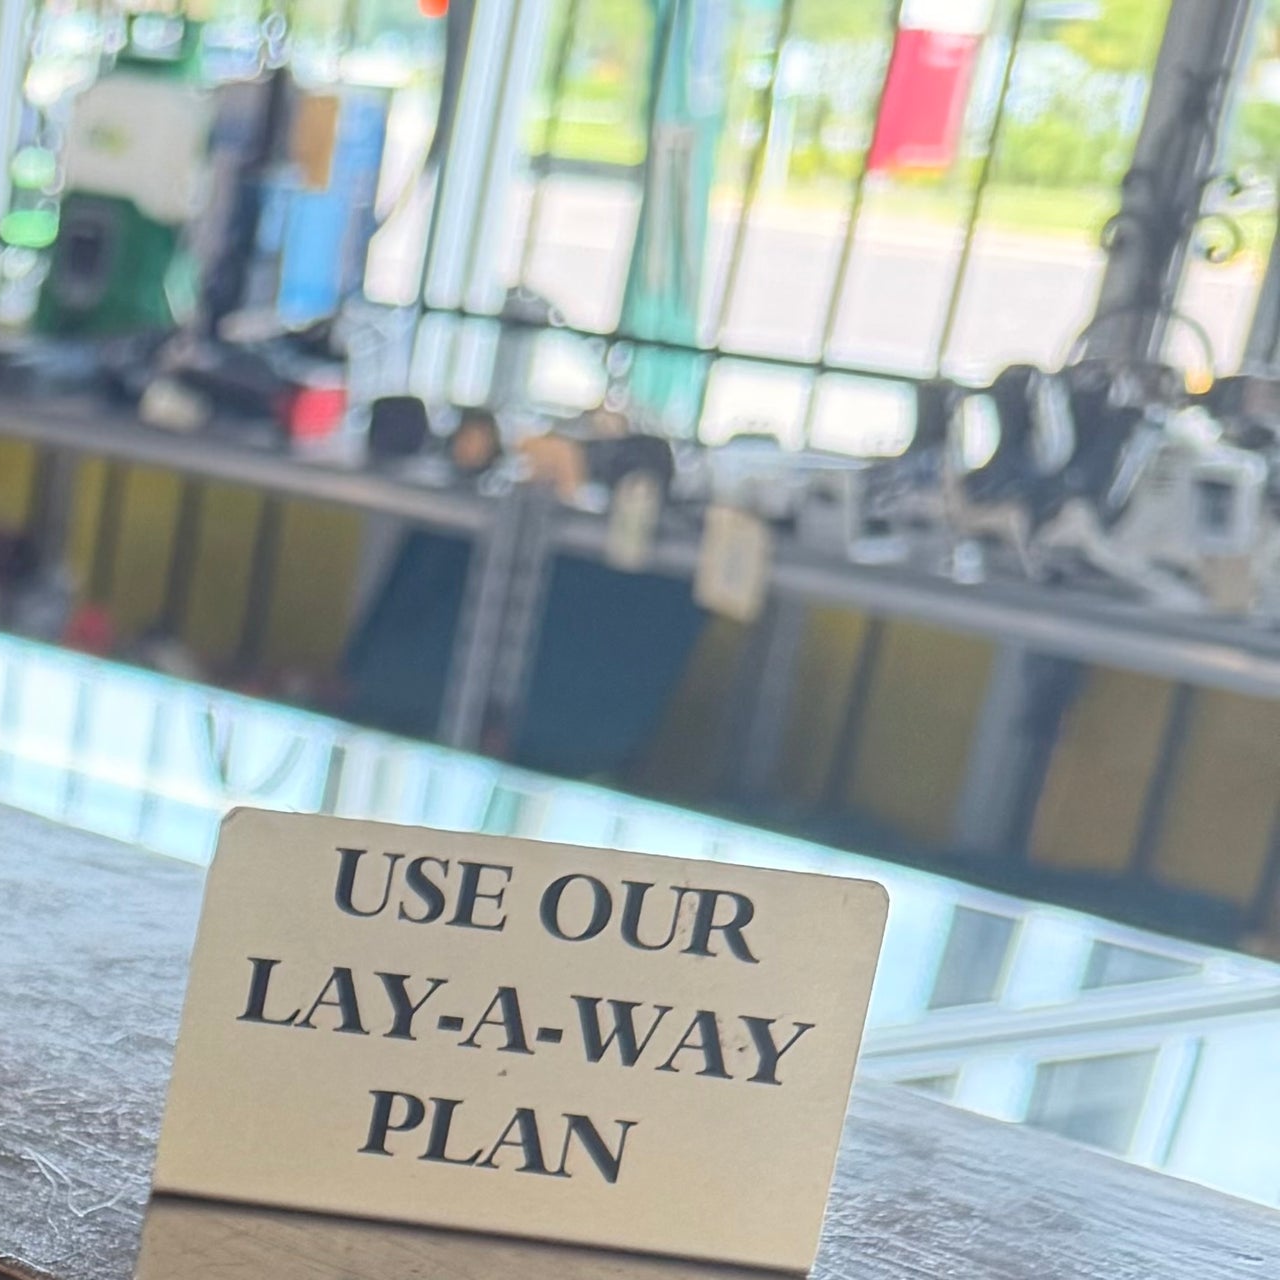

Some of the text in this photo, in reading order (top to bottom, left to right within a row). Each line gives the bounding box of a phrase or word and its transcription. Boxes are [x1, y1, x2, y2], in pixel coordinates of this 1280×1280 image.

[334, 847, 761, 964] USE OUR
[236, 957, 815, 1086] LAY-A-WAY
[357, 1090, 638, 1185] PLAN
